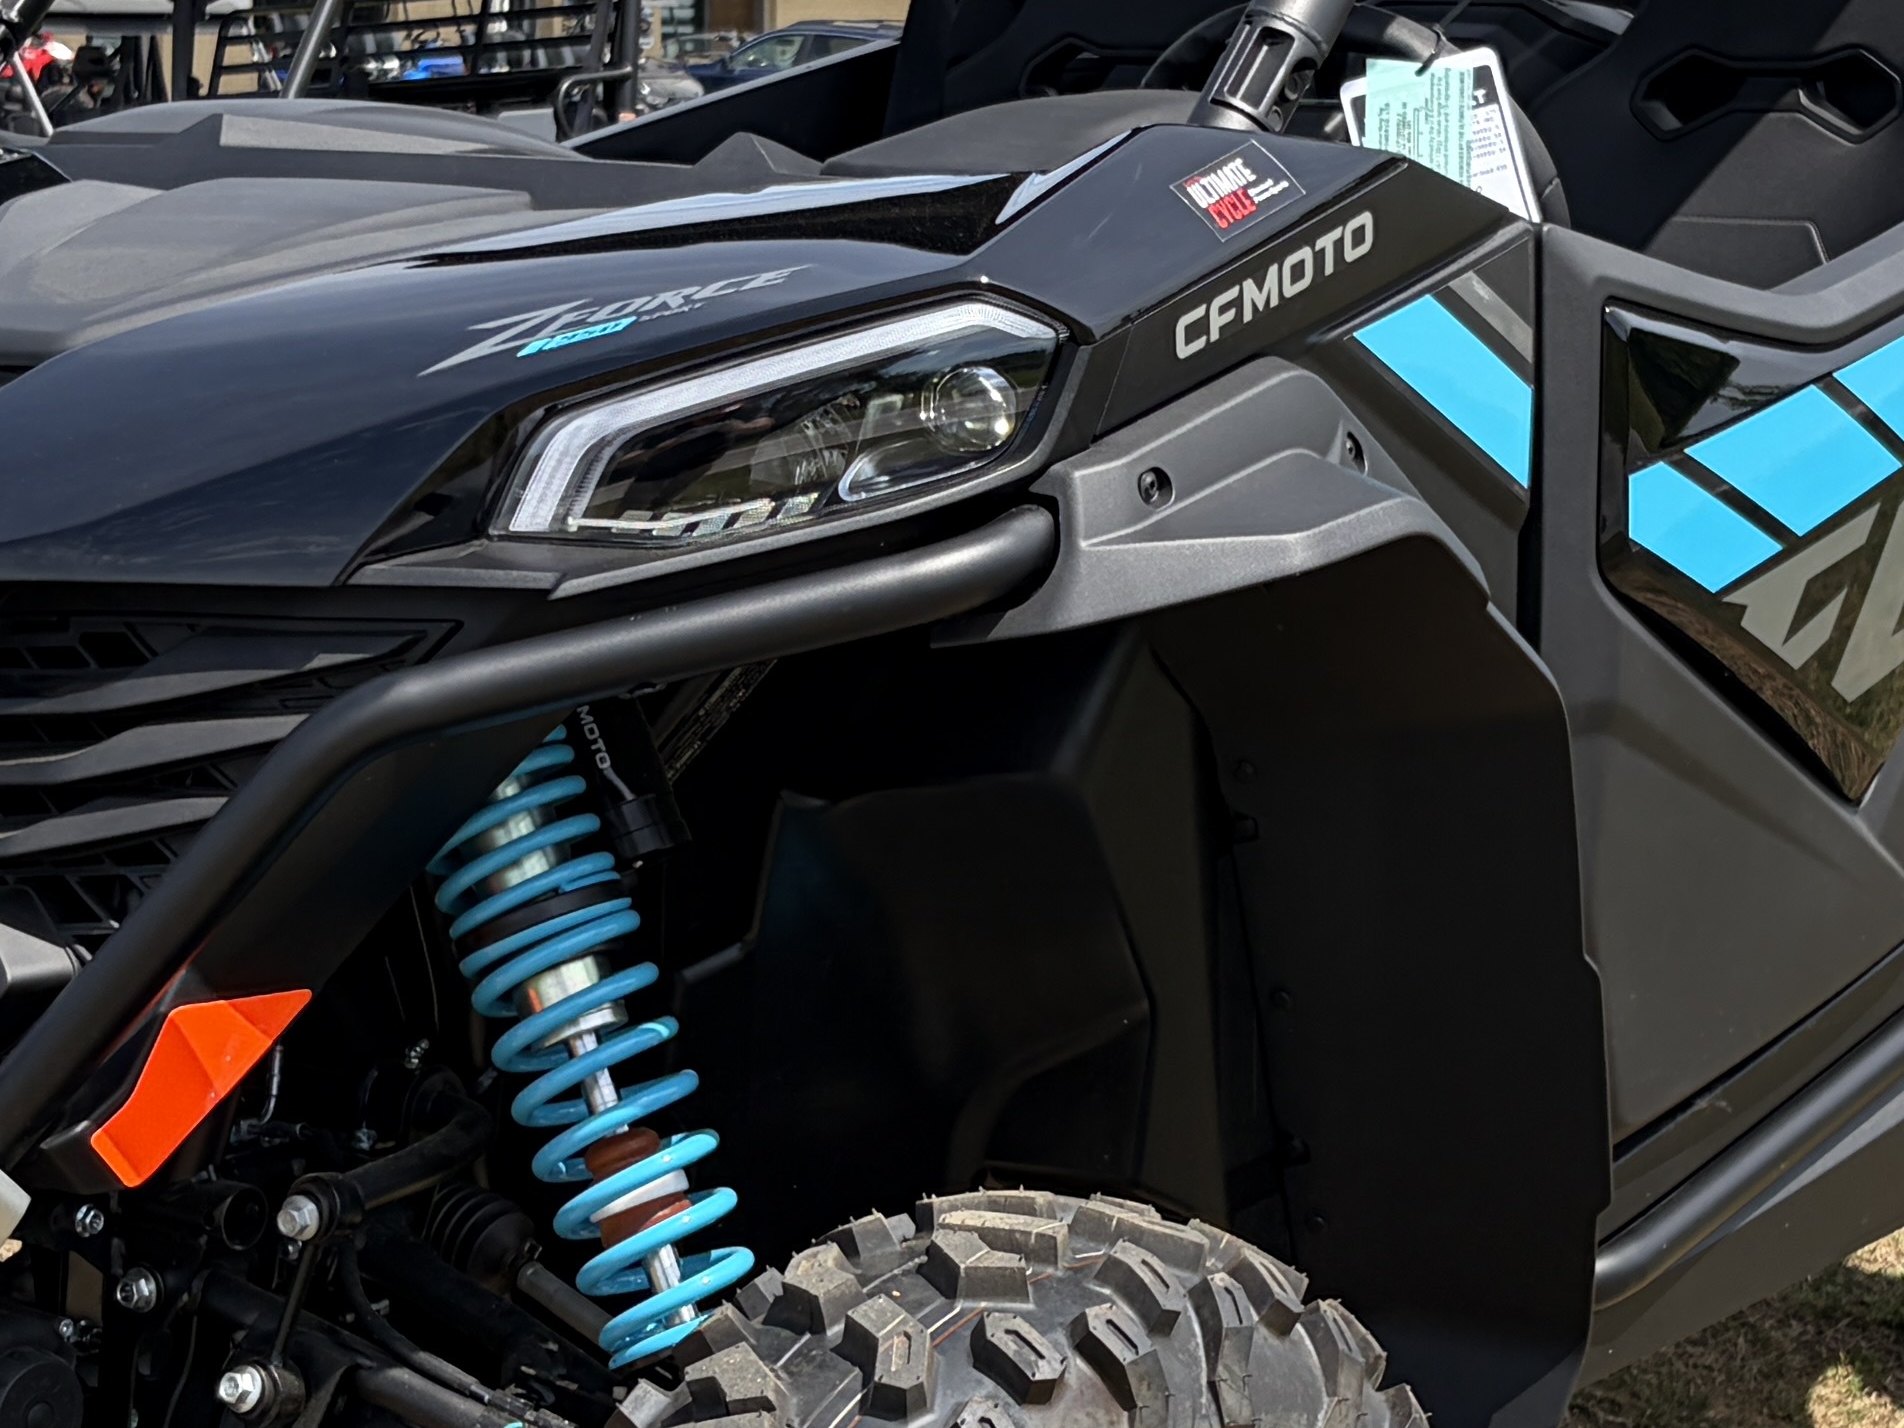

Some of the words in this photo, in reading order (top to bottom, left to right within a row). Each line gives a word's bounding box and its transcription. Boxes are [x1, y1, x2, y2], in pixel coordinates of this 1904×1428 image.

[1186, 157, 1257, 209] ULTIMATE
[1206, 187, 1258, 229] CYCLE
[1174, 211, 1374, 360] CFMOTO
[576, 704, 611, 770] MOTO
